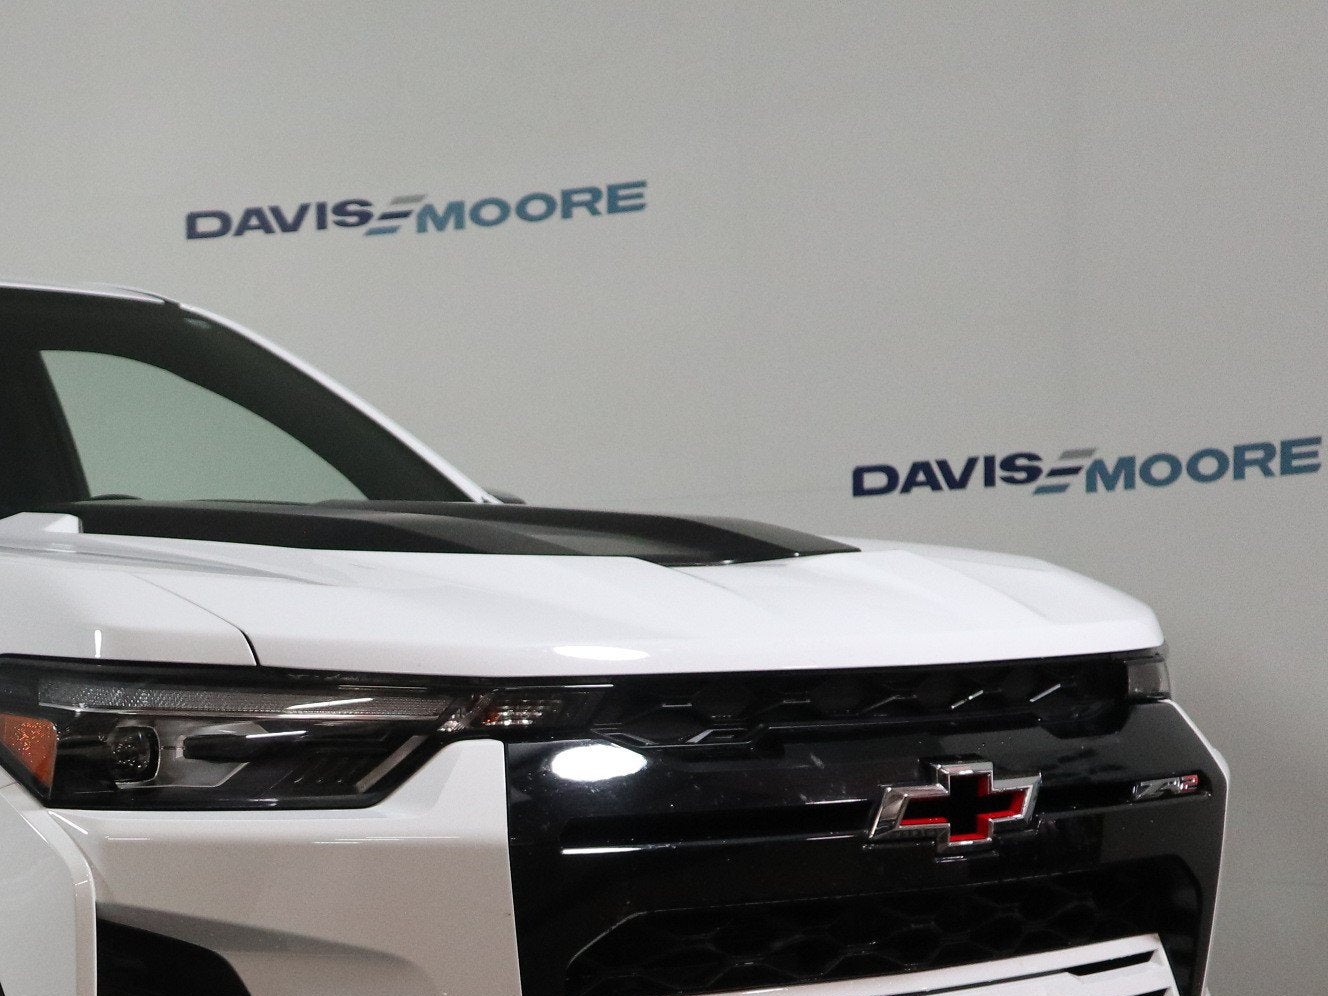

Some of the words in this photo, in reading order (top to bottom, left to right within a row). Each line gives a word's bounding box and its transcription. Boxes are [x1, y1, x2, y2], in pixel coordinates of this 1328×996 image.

[185, 199, 374, 240] DAVIS
[416, 180, 648, 234] MOORE
[852, 452, 1044, 498] DAVIS
[1085, 436, 1323, 494] MOORE
